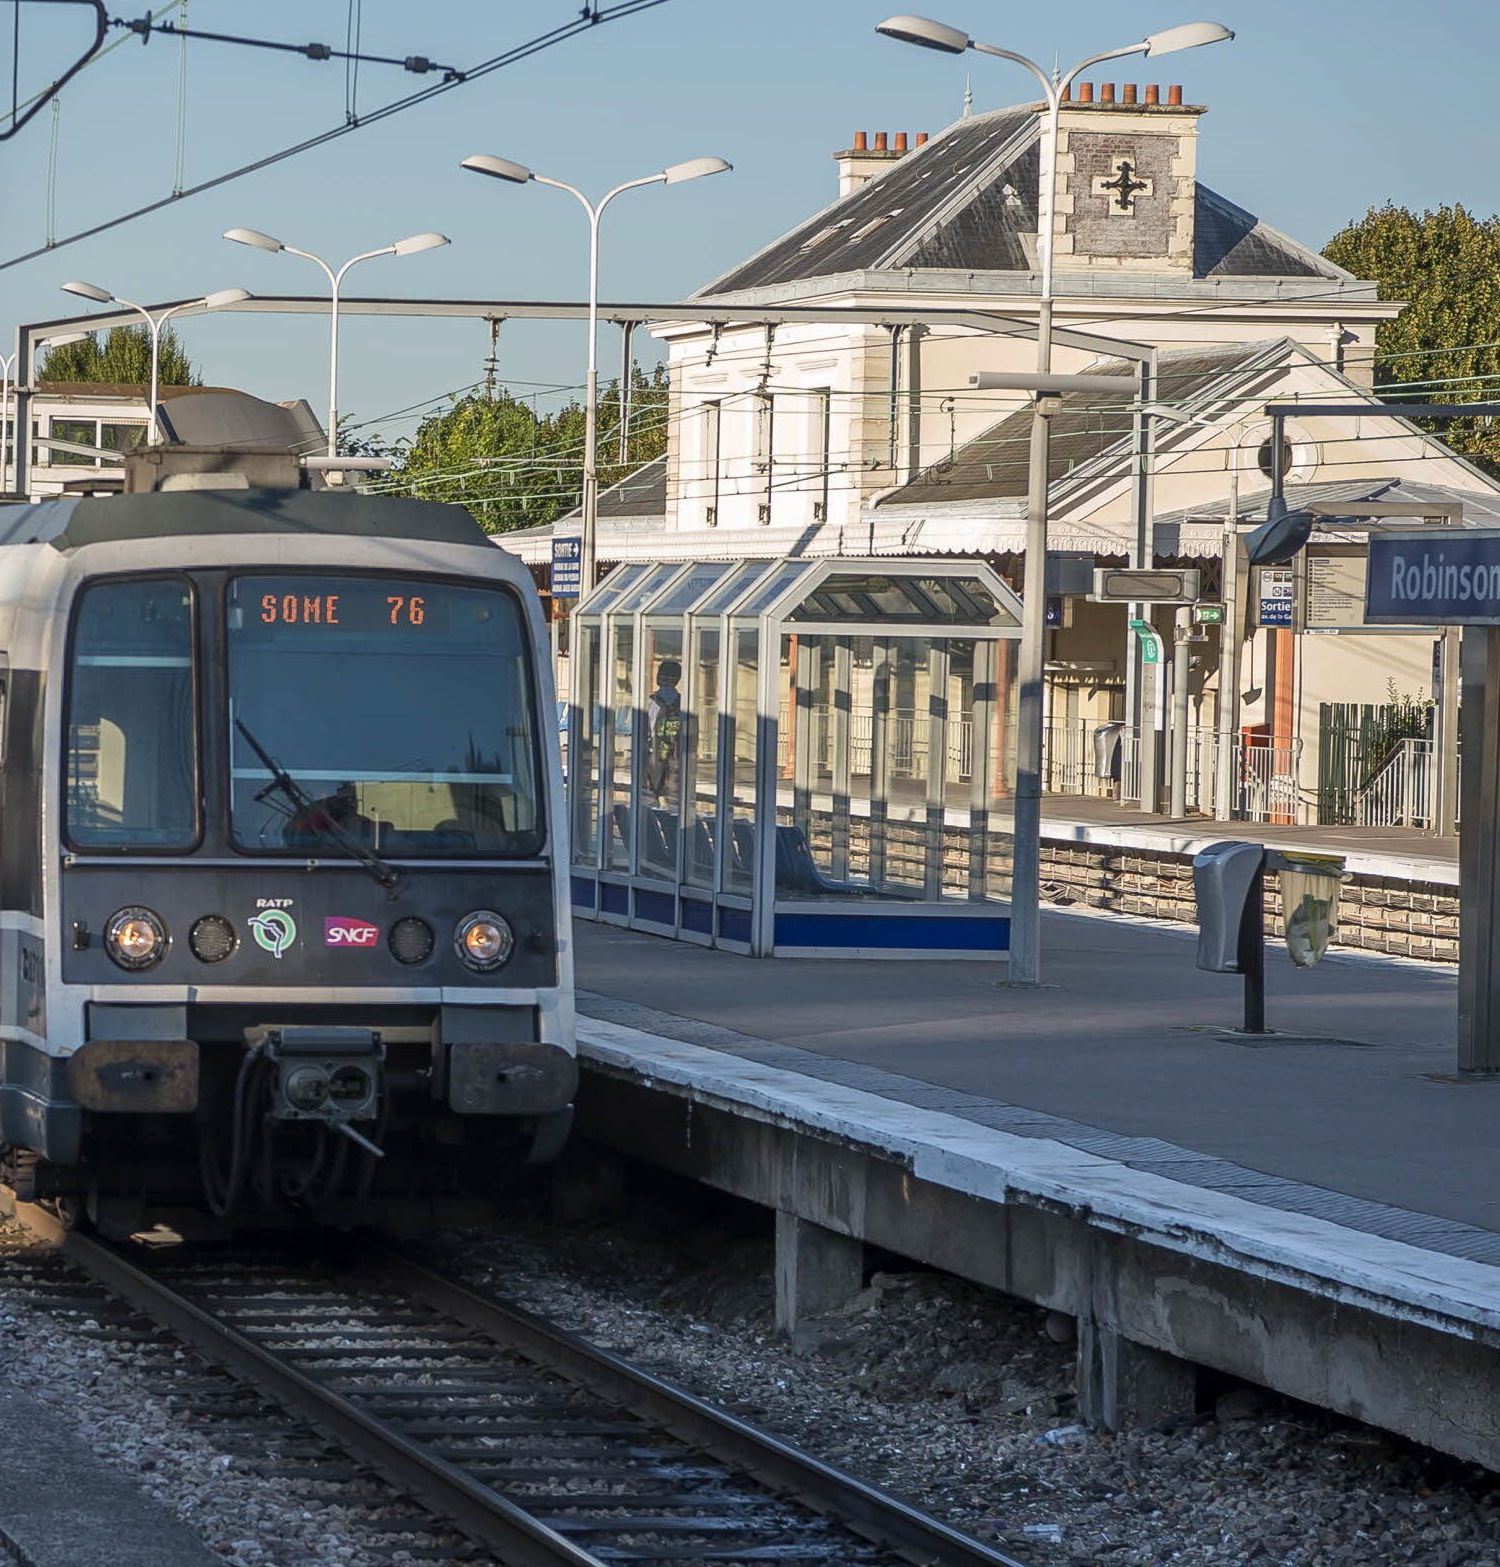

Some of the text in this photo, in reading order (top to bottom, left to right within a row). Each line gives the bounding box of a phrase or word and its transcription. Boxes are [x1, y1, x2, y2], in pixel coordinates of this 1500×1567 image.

[1391, 553, 1500, 601] Robinson
[261, 595, 425, 625] SOME 76
[1261, 601, 1291, 611] Sortie
[256, 899, 293, 908] RATP
[326, 927, 377, 943] SNCF
